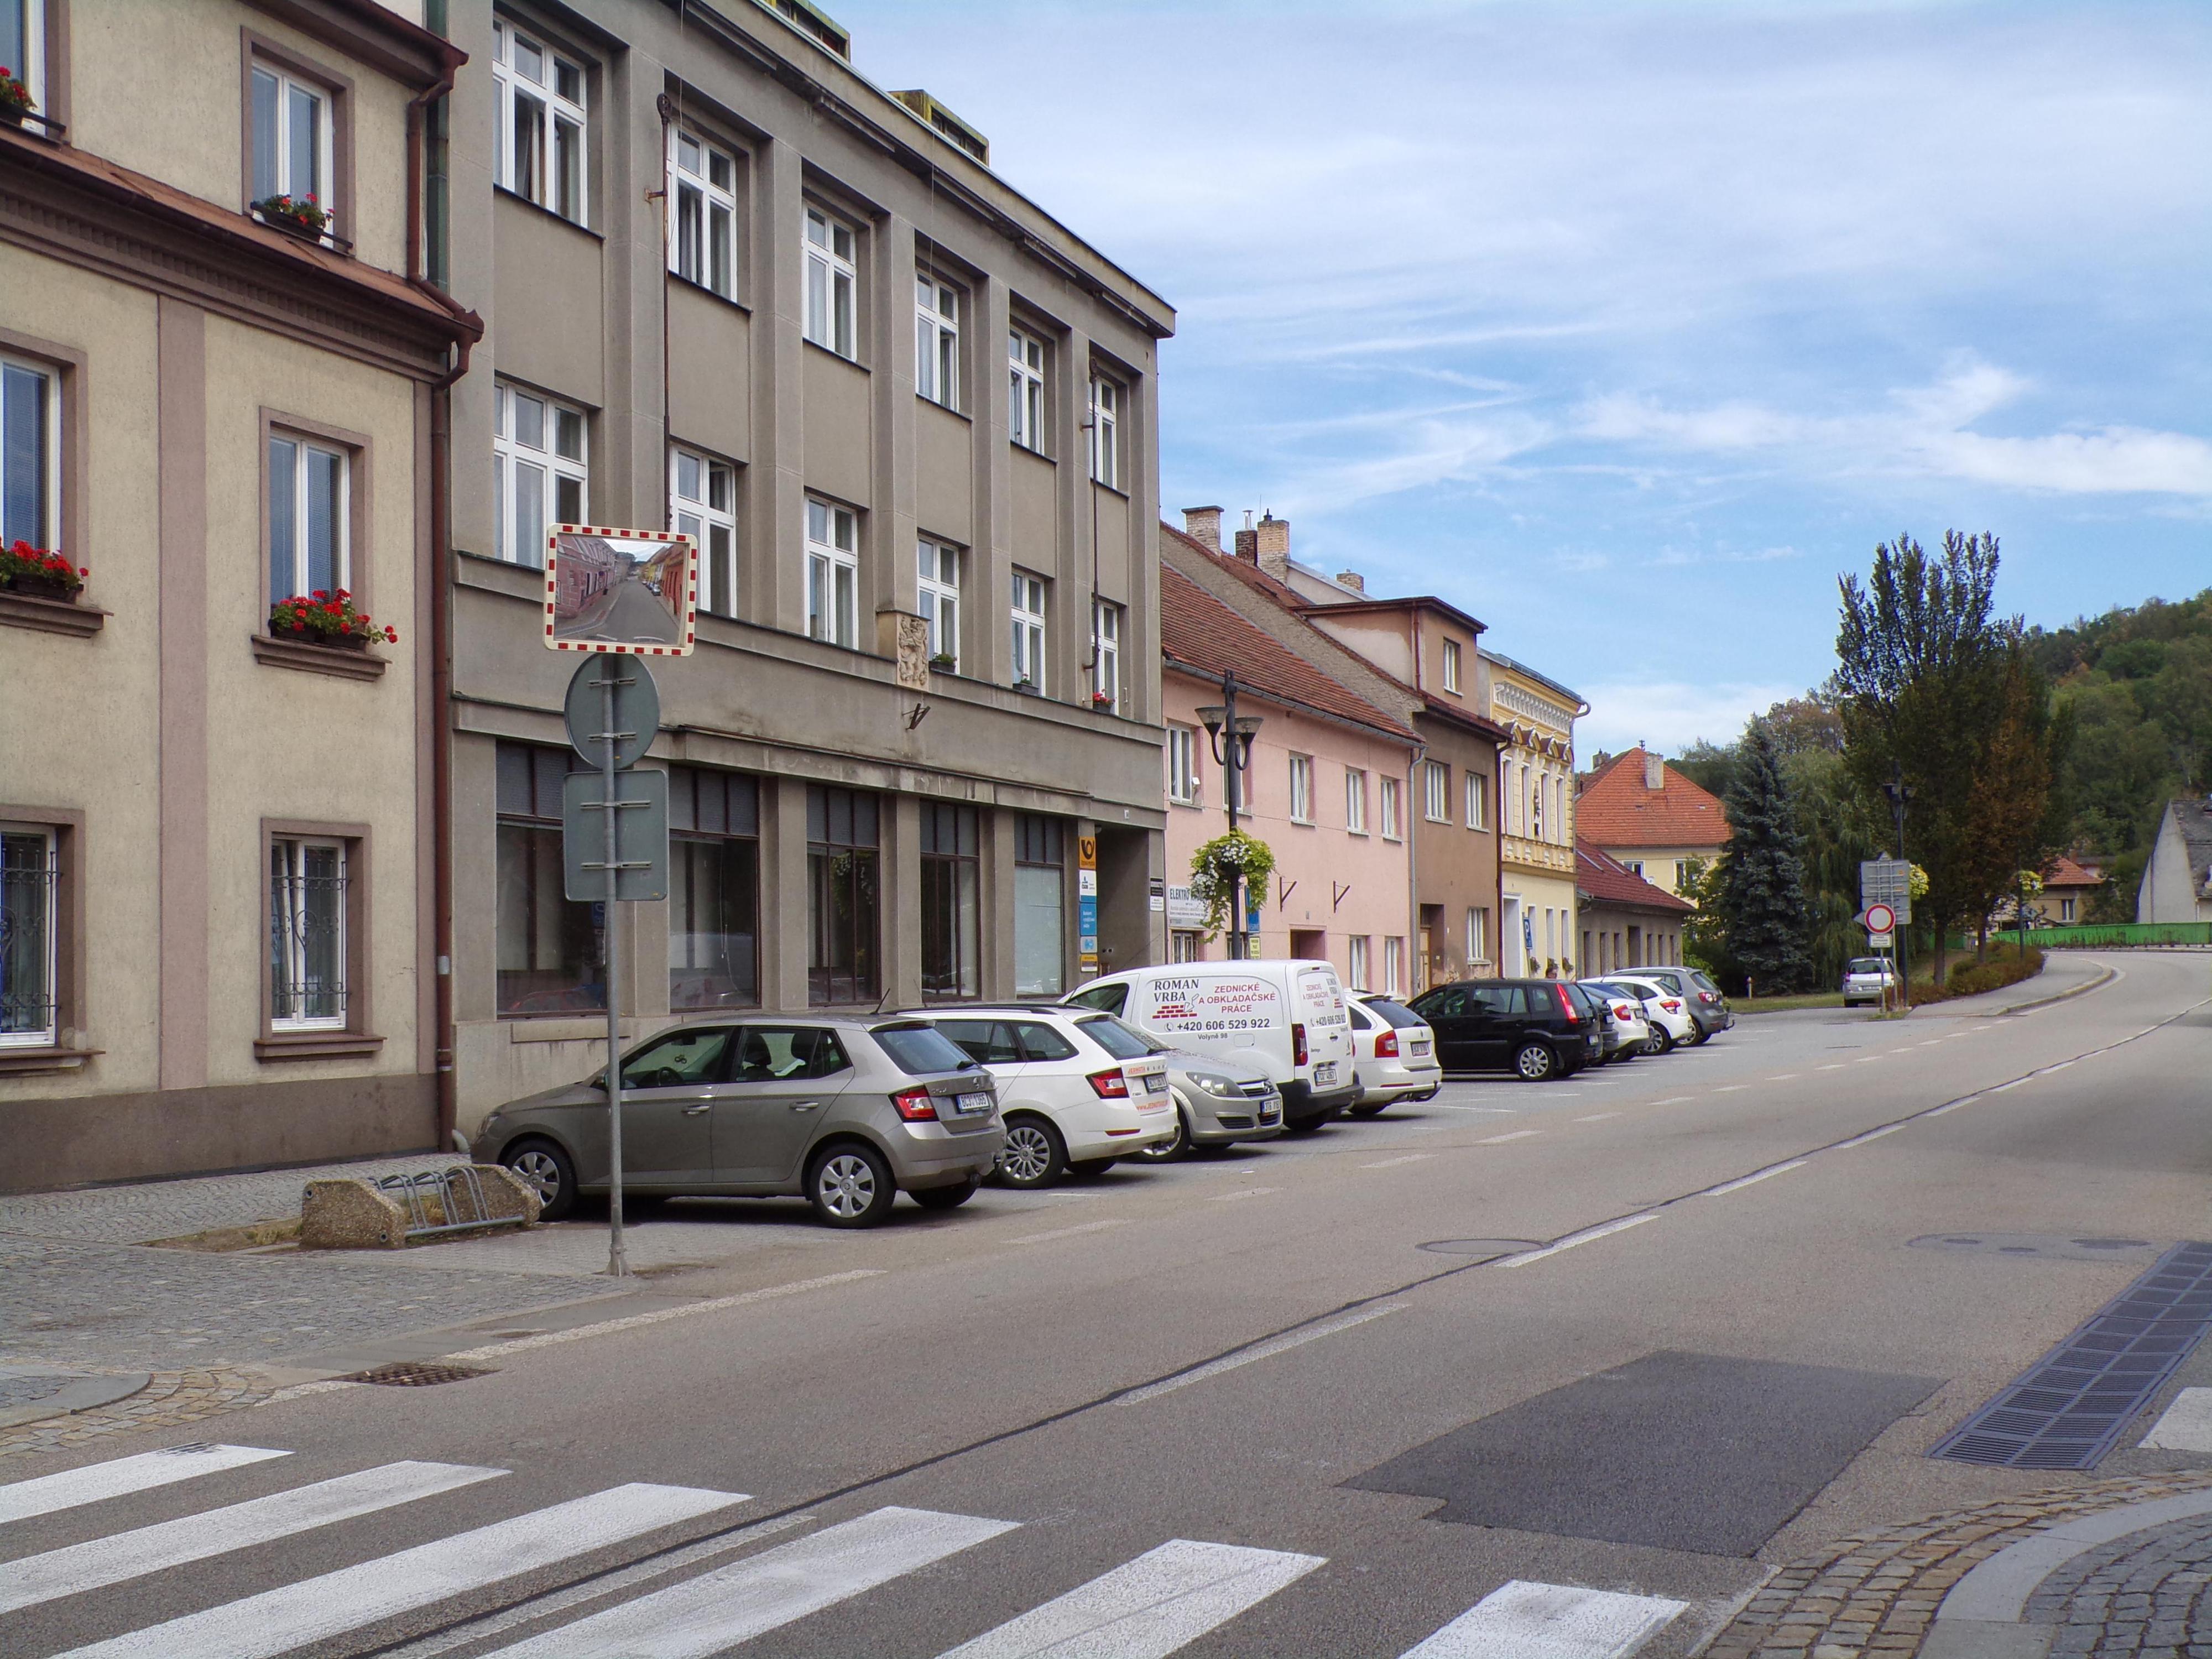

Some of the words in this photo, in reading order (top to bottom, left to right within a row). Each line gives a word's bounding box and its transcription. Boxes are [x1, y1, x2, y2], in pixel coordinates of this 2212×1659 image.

[1525, 921, 1530, 939] P
[1154, 979, 1199, 990] ROMAN
[1214, 983, 1260, 993] ZEDNICKÉ
[1154, 992, 1186, 1002] VRBA
[1207, 992, 1276, 1003] OBKLADAČSKÉ
[1221, 1004, 1253, 1014] PRÁCE
[1177, 1021, 1202, 1031] +420
[1206, 1020, 1225, 1030] 606
[1228, 1019, 1247, 1029] 529
[1250, 1018, 1270, 1028] 922
